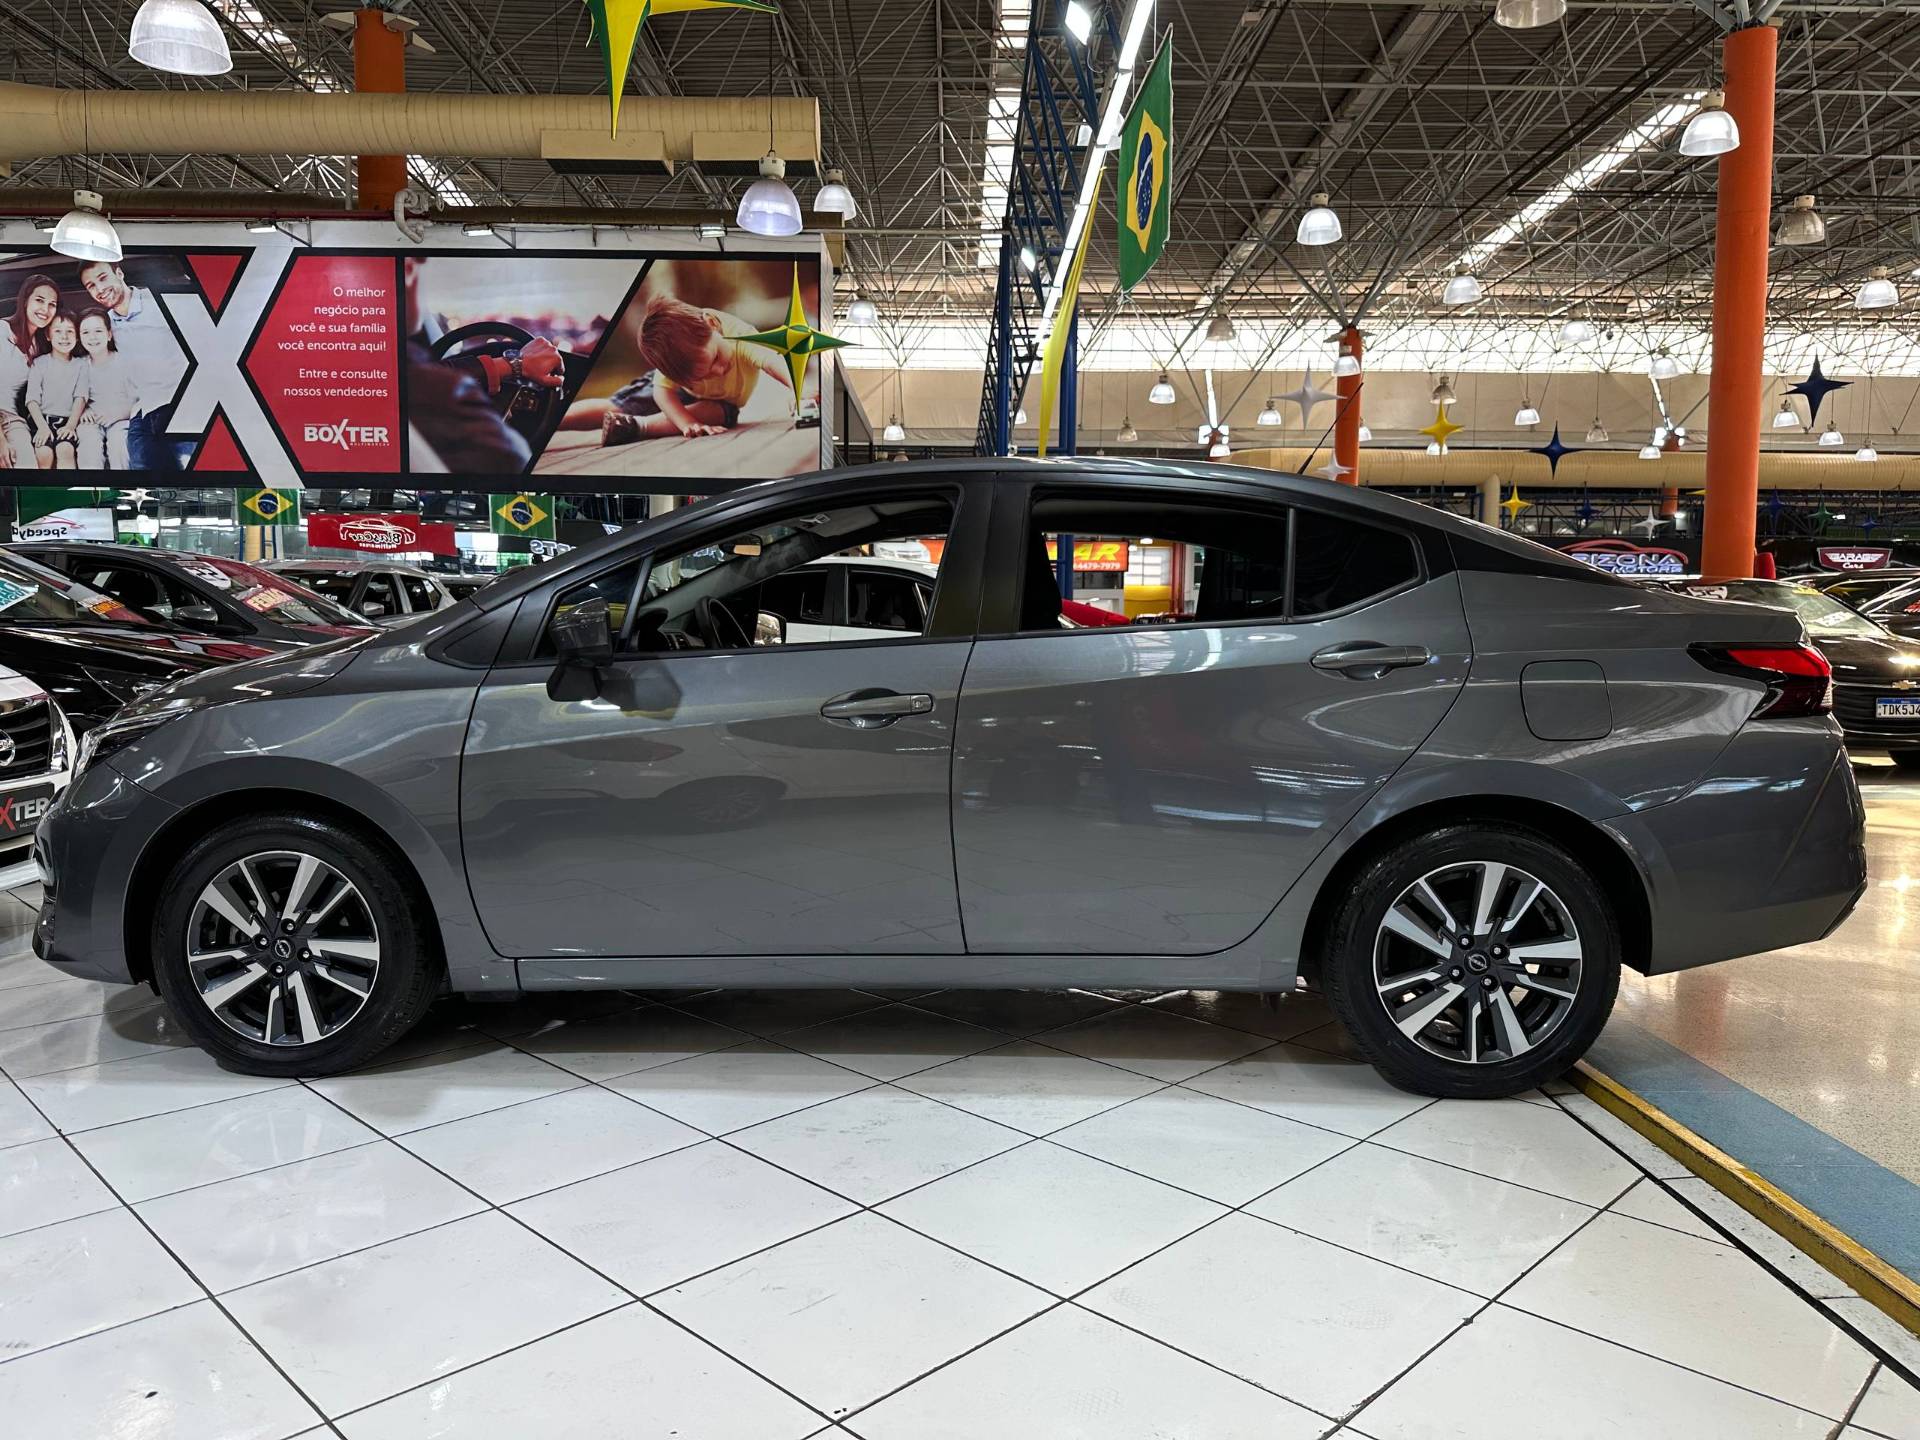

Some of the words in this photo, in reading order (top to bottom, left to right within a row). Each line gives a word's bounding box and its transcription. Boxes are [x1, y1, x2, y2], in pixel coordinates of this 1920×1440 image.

[333, 286, 343, 297] O
[346, 287, 386, 297] melhor
[314, 305, 359, 317] negócio
[361, 306, 386, 317] para
[289, 322, 316, 333] você
[318, 324, 326, 333] e
[328, 324, 347, 333] sua
[350, 322, 387, 333] família
[278, 340, 304, 350] você
[307, 341, 357, 351] encontra
[359, 341, 387, 353] aqui!
[299, 368, 328, 379] Entre
[330, 371, 338, 379] e
[340, 369, 388, 379] consulte
[283, 387, 321, 397] nossos
[324, 387, 388, 397] vendedores
[304, 419, 389, 450] BOXTER
